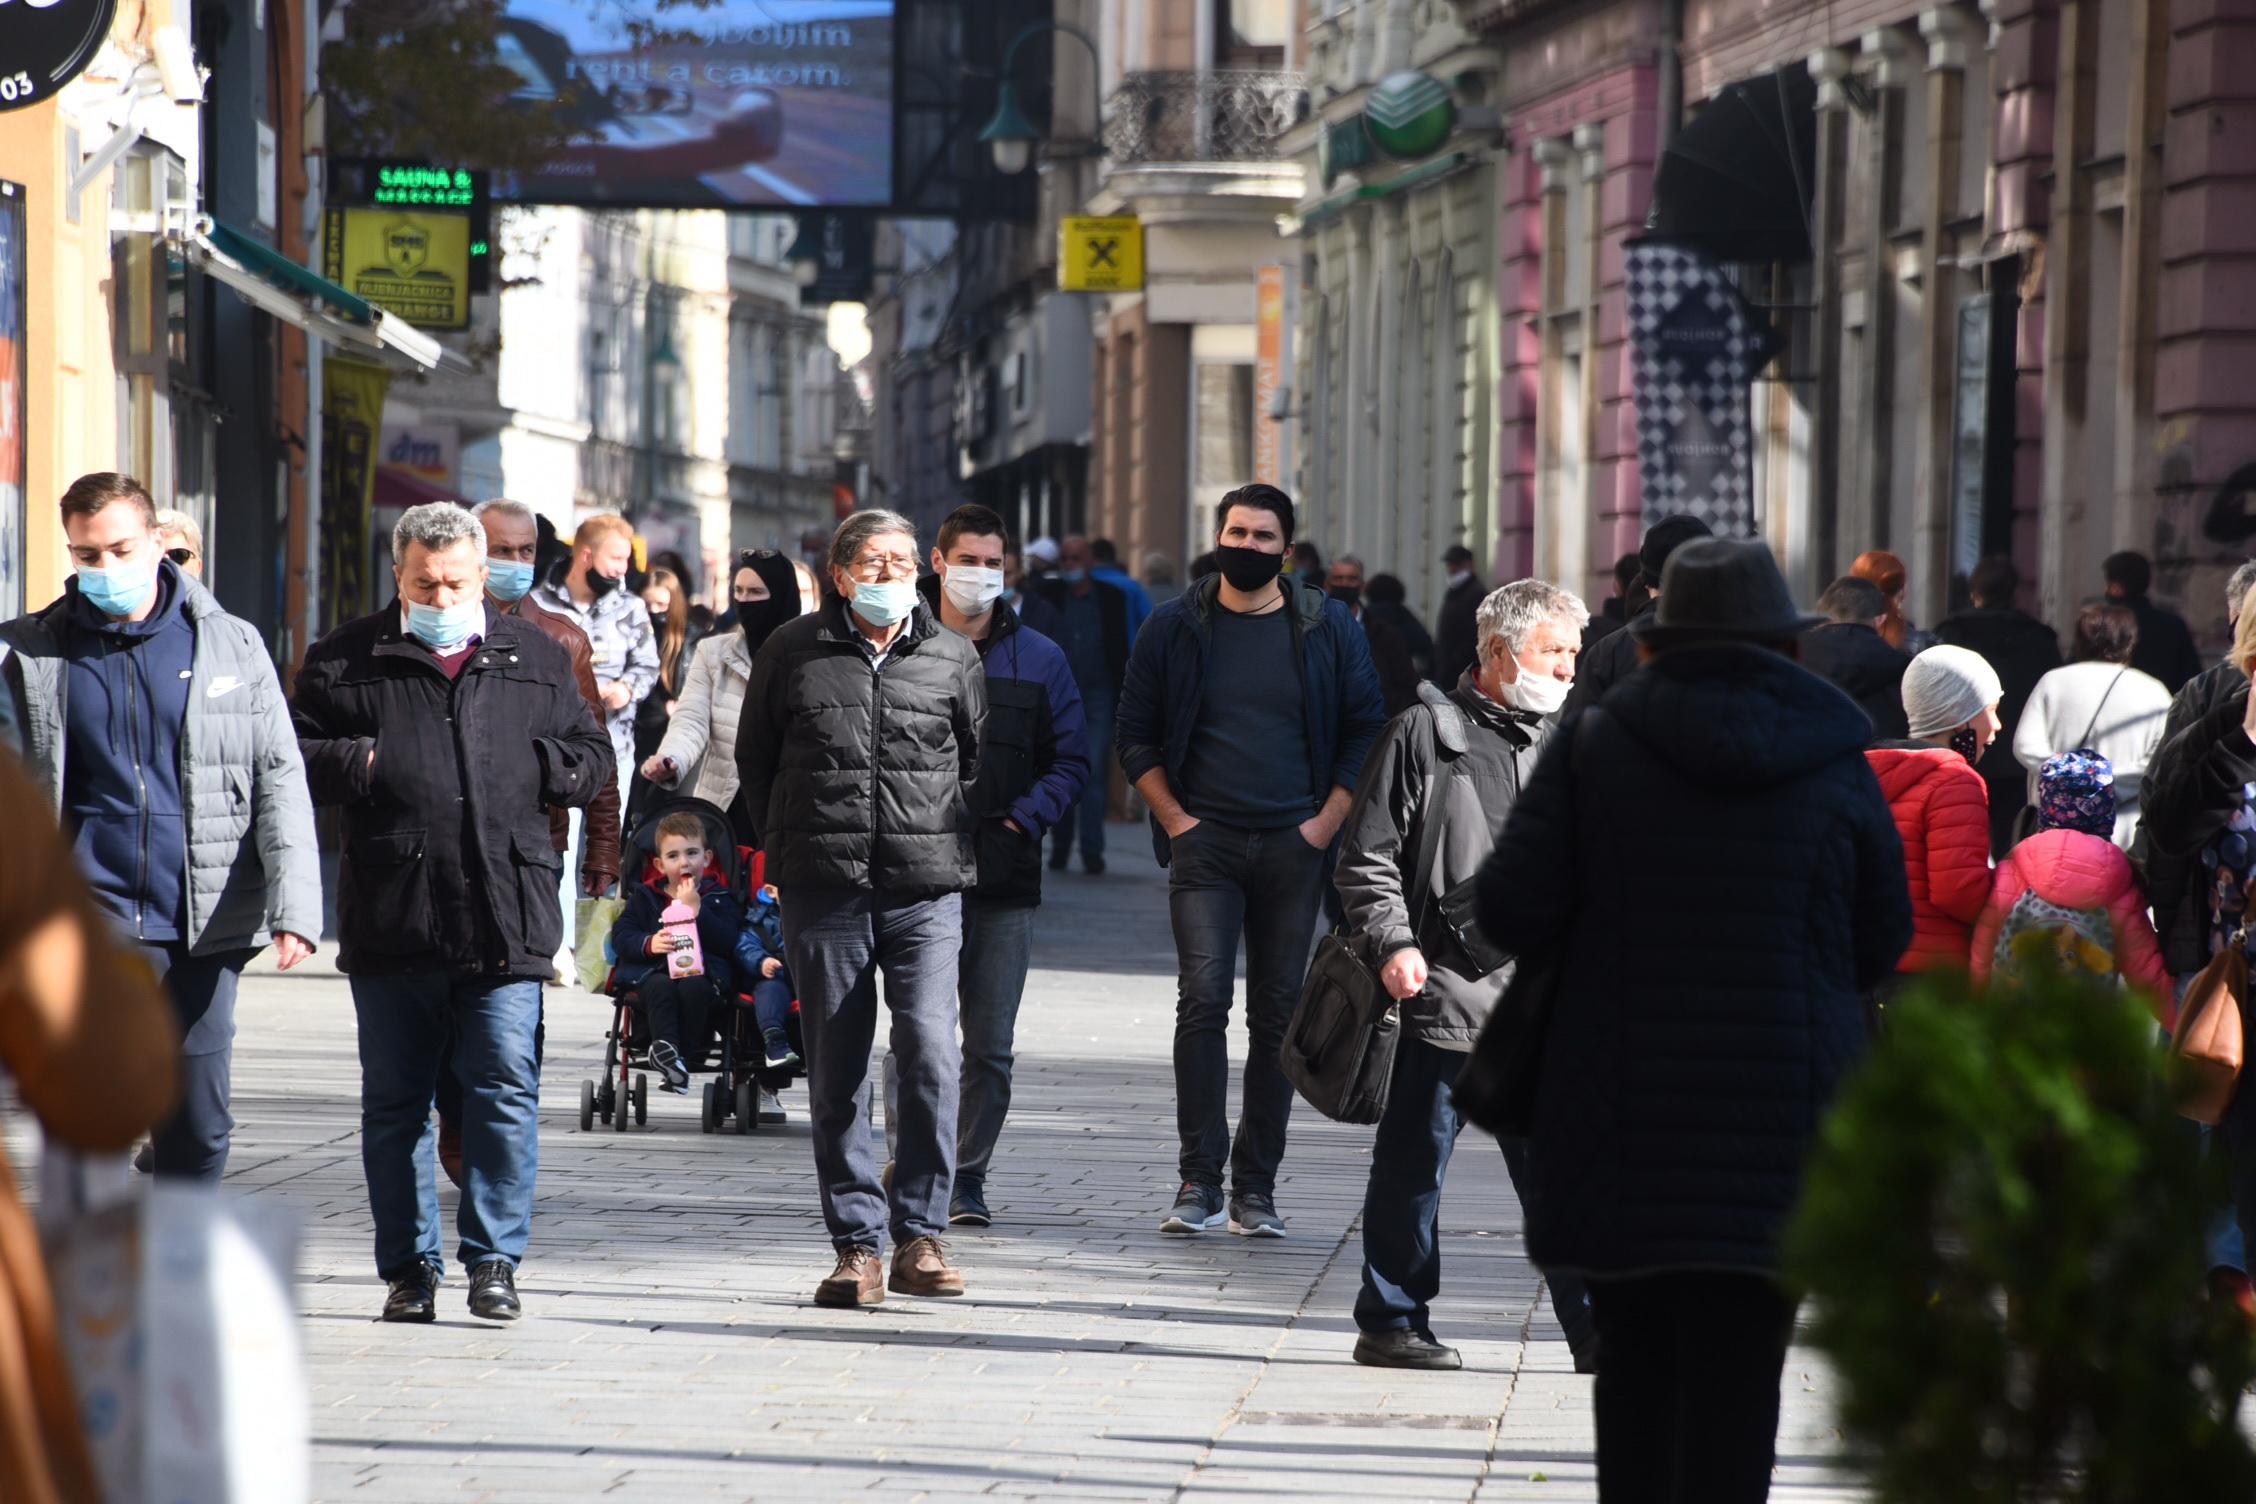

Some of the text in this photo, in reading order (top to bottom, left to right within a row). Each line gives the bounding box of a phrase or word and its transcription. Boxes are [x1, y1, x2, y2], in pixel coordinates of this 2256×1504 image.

[565, 58, 651, 82] rent
[667, 63, 690, 82] a
[379, 165, 451, 188] SAUNA
[1255, 359, 1273, 482] ANKOMAT
[389, 429, 441, 462] dm
